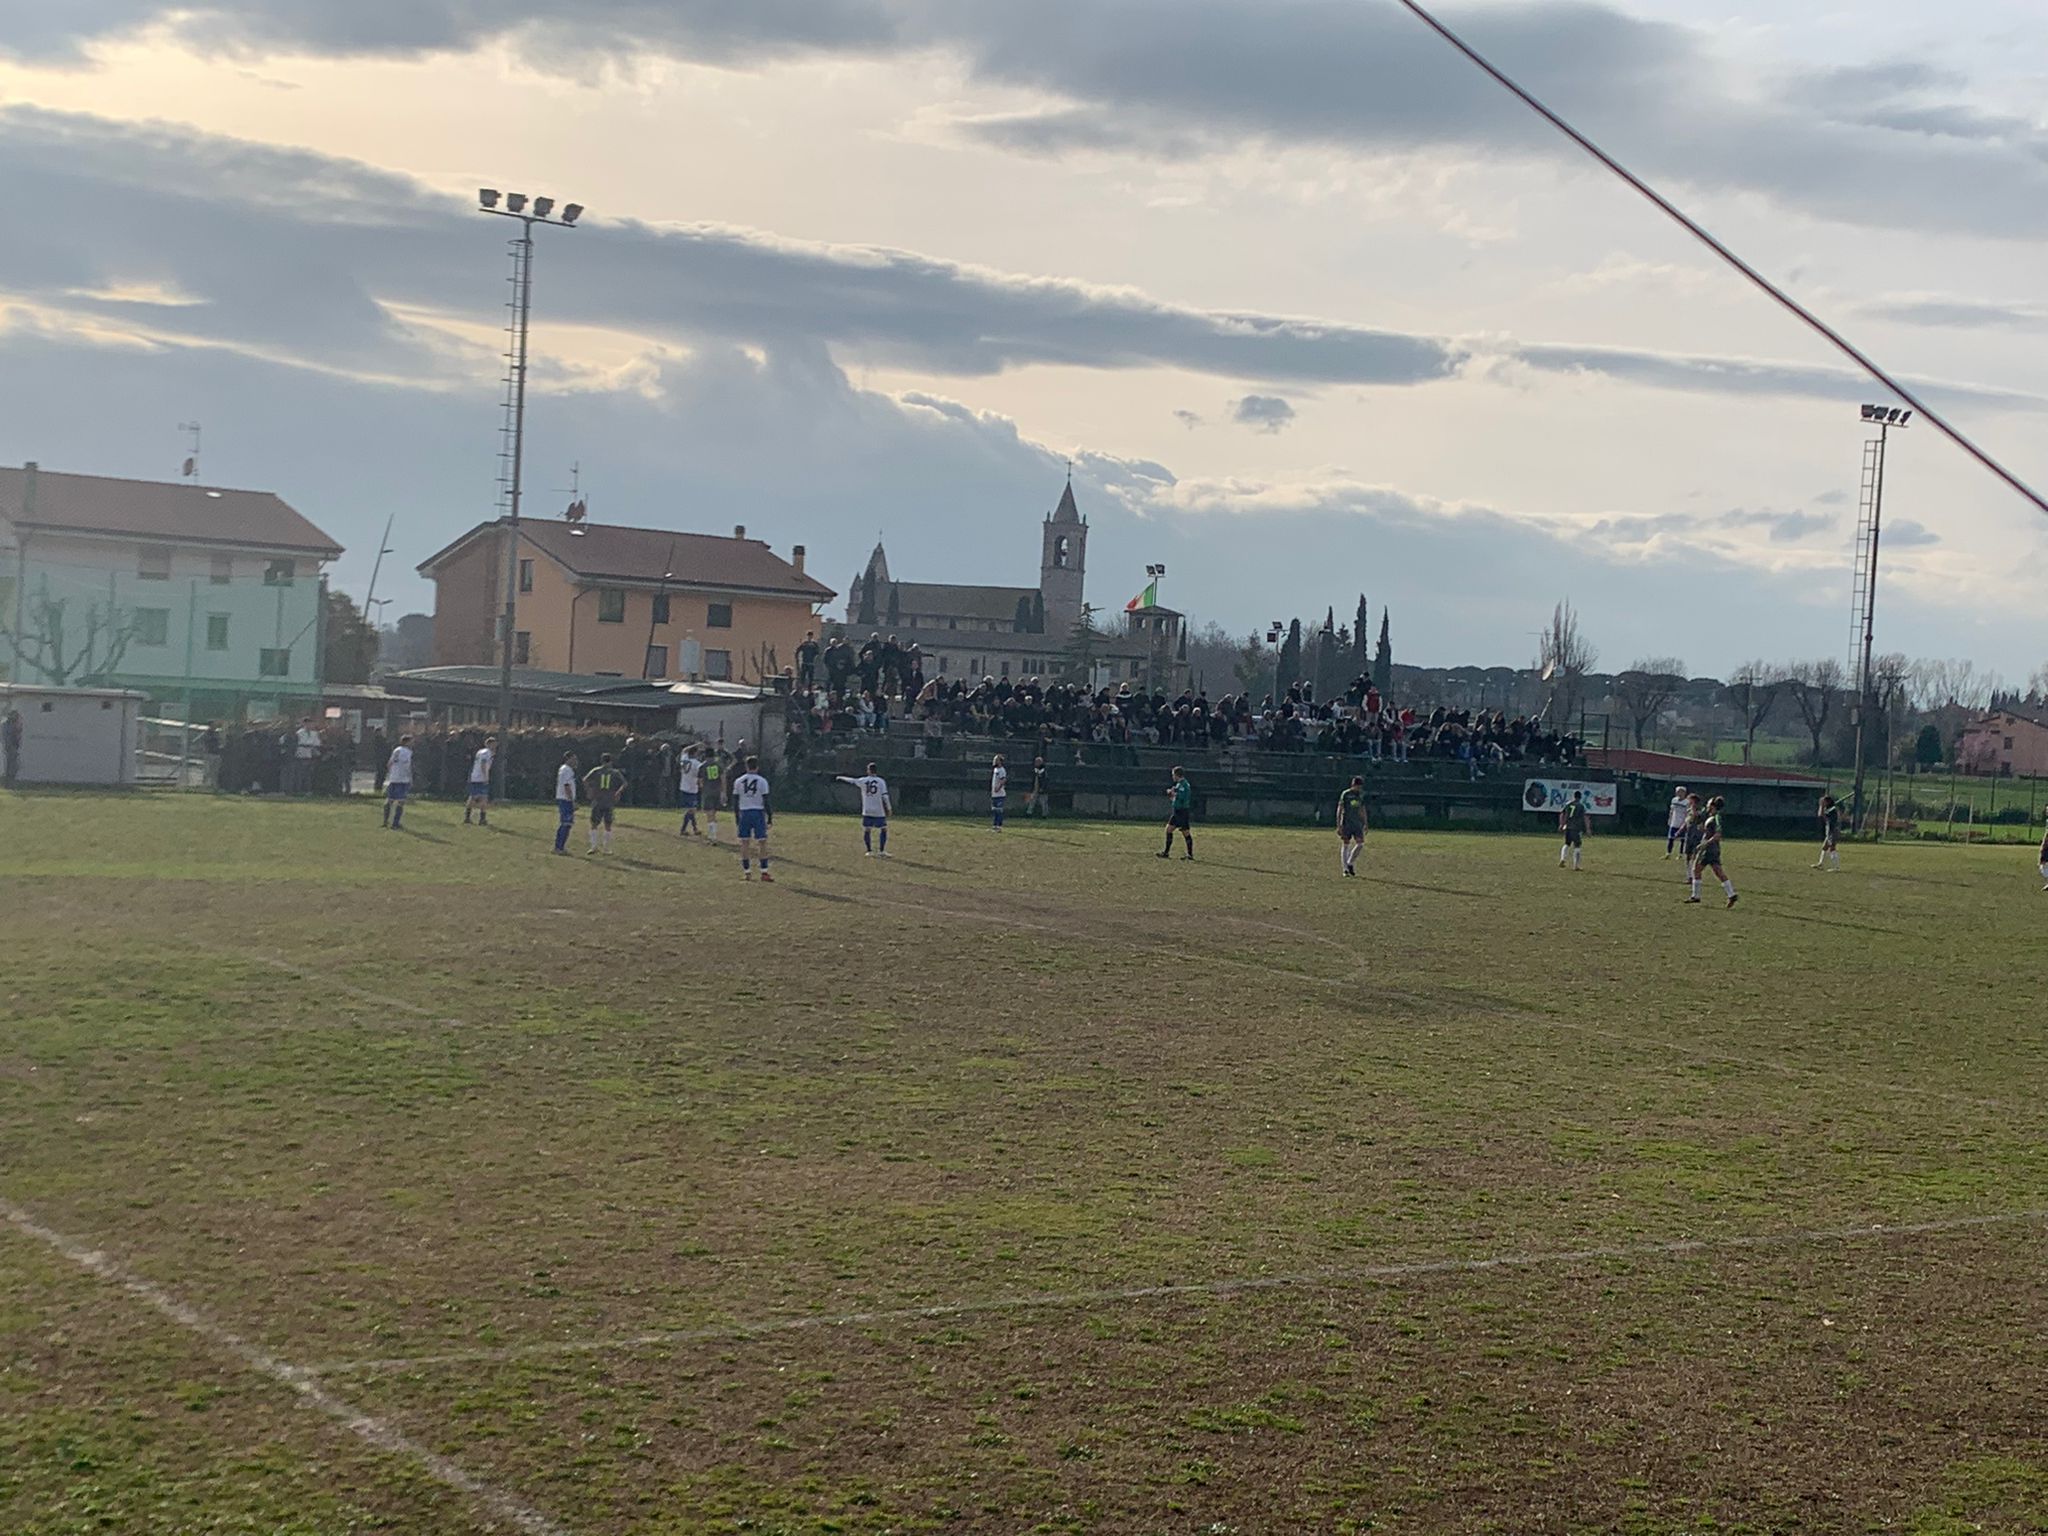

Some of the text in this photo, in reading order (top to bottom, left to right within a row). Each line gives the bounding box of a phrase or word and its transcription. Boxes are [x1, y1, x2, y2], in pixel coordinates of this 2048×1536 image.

[601, 774, 611, 789] 11
[741, 779, 758, 794] 14
[865, 780, 878, 794] 16
[1569, 805, 1576, 818] 7
